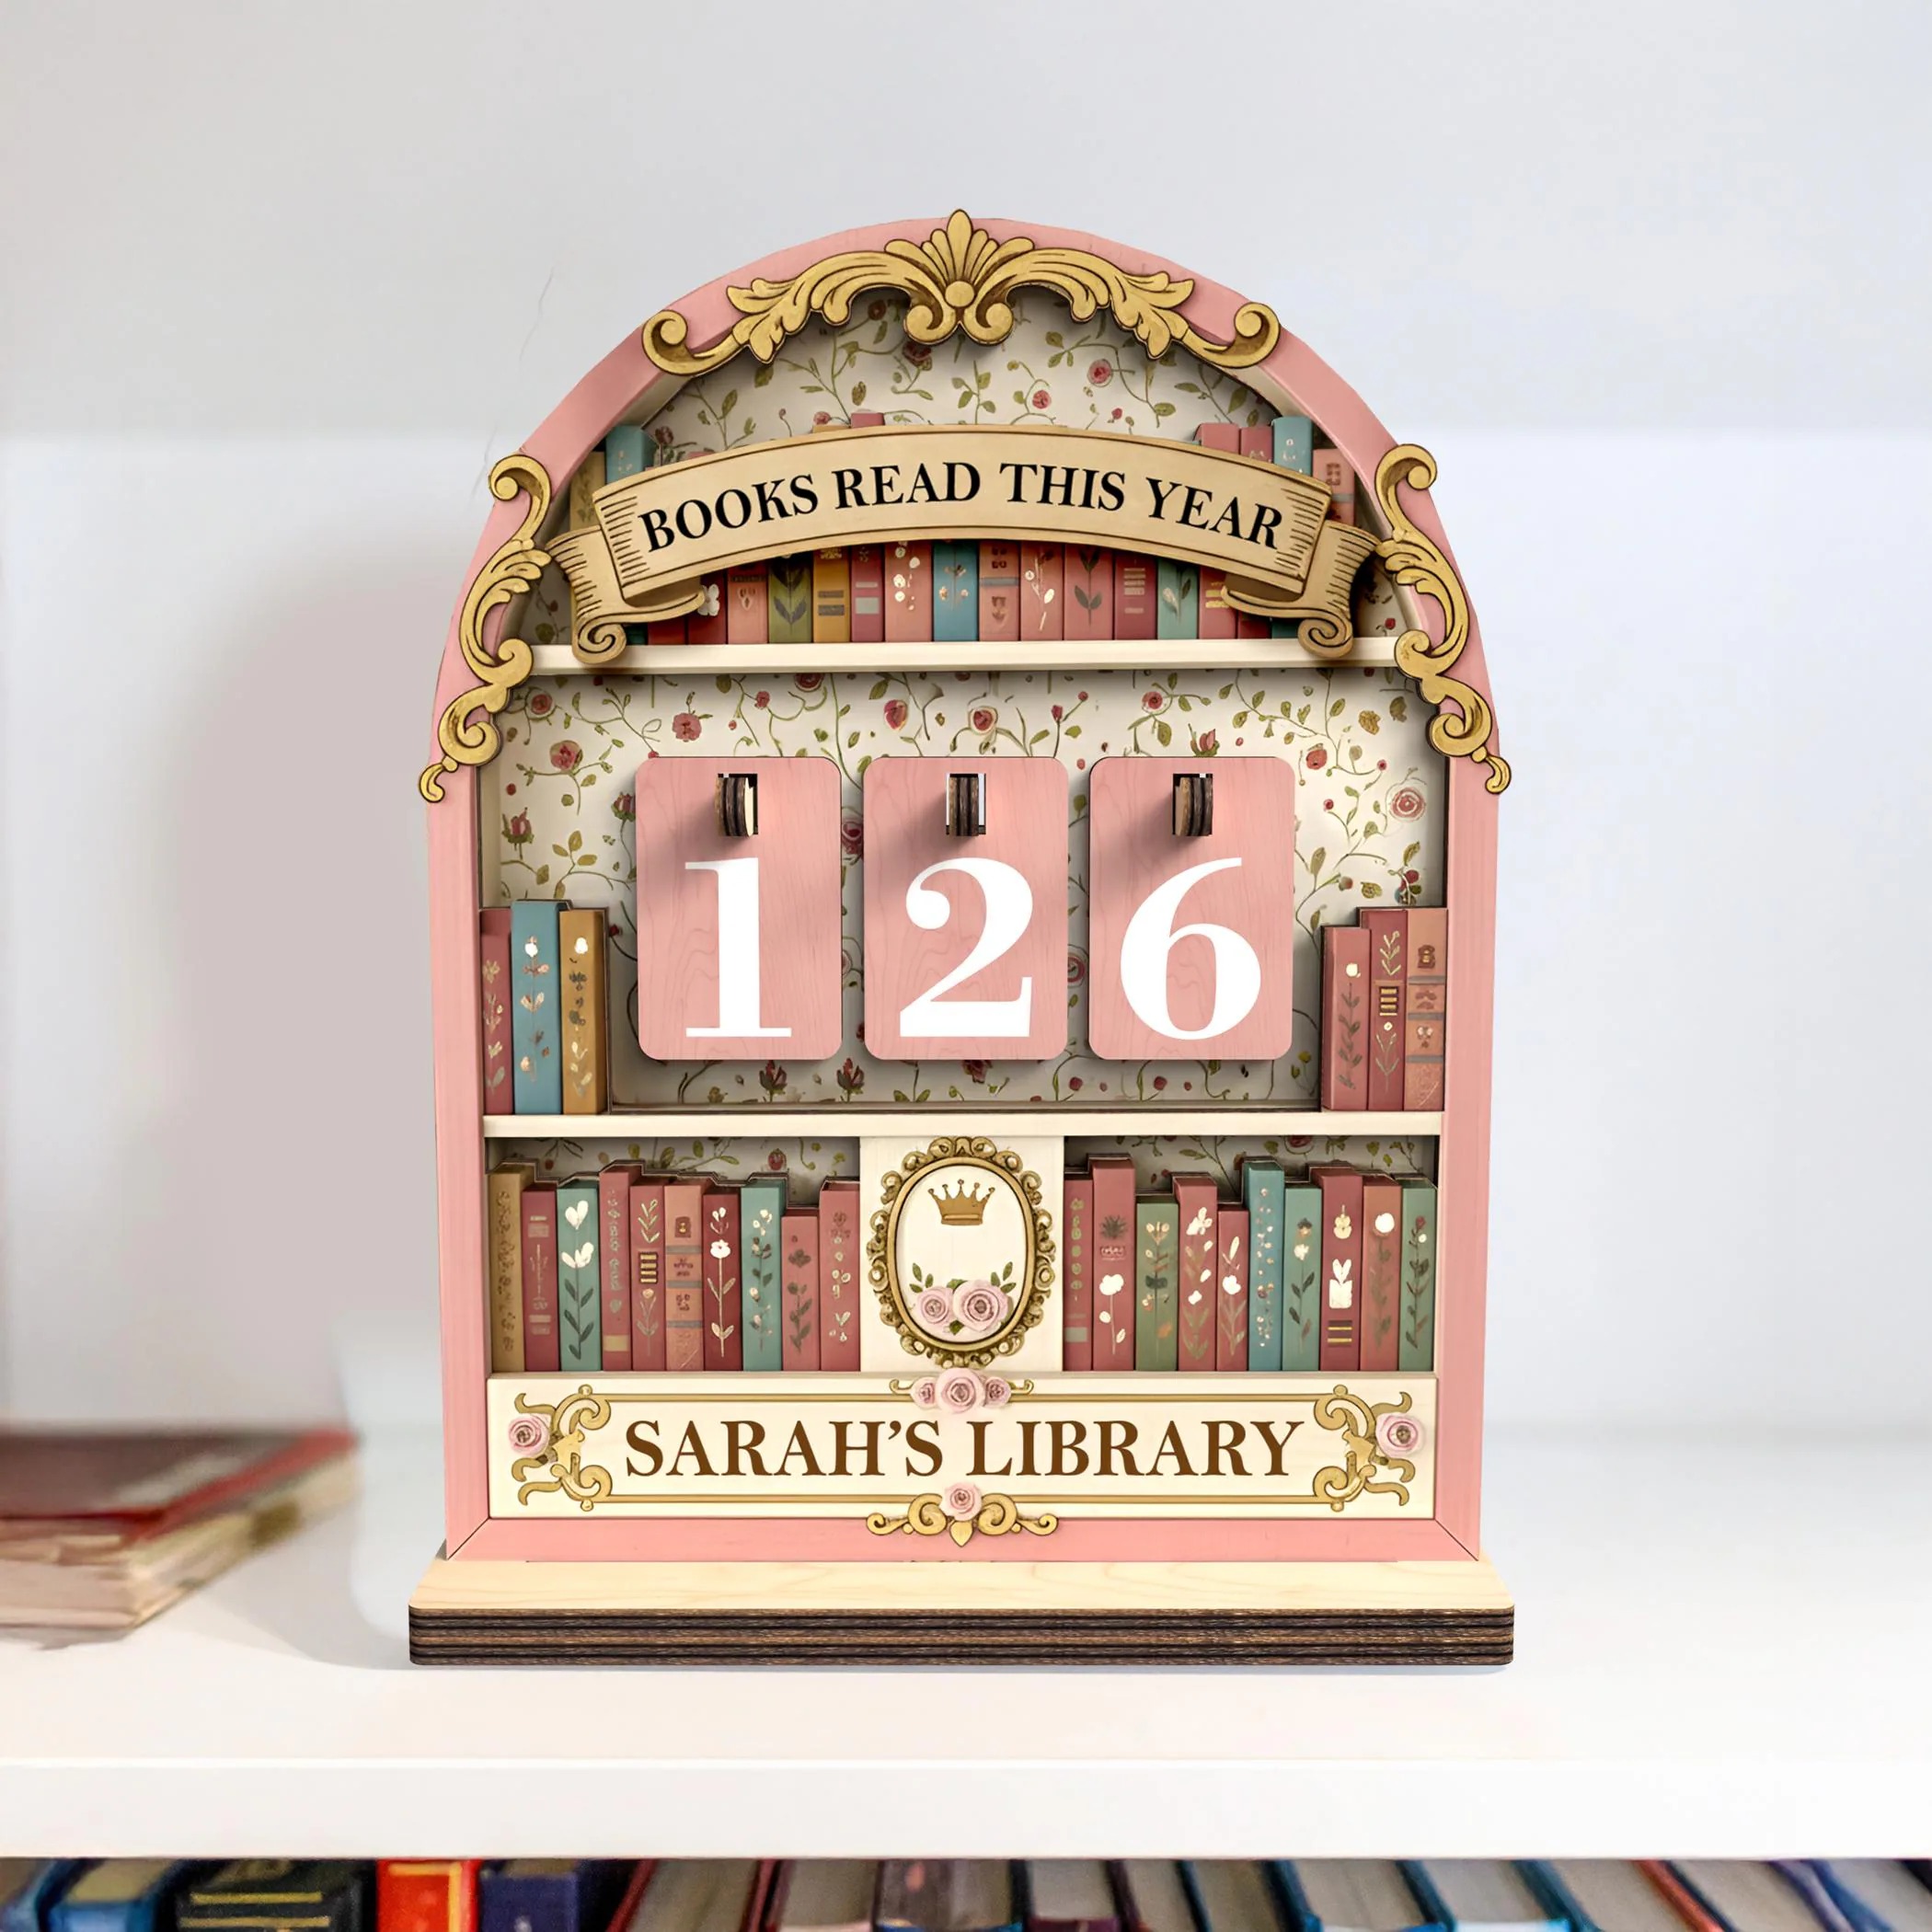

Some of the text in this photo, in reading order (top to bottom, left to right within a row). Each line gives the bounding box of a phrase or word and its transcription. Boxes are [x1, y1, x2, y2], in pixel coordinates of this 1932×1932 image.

[637, 461, 1283, 554] BOOKS READ THIS YEAR
[625, 1420, 1305, 1478] SARAH'S LIBRARY
